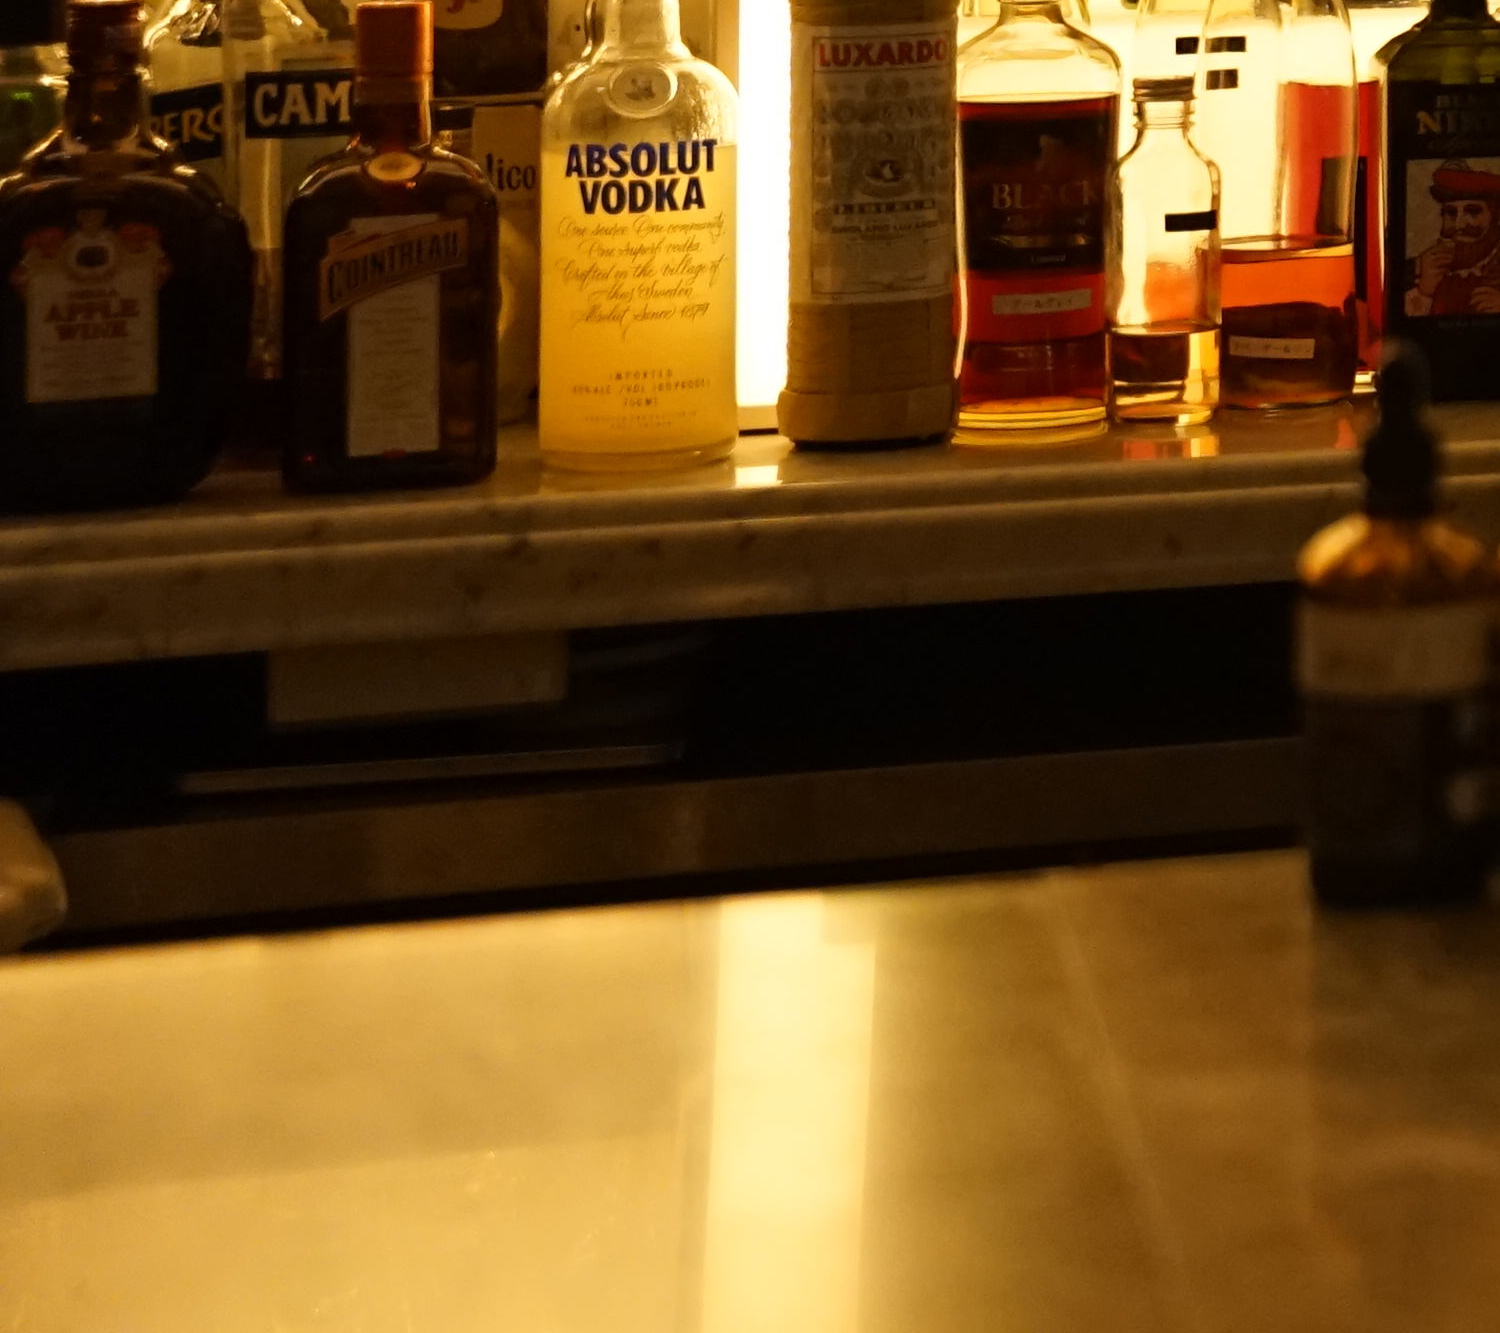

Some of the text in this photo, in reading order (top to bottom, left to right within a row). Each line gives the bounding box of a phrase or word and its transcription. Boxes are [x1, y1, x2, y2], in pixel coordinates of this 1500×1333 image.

[818, 37, 948, 69] LUXARDO
[564, 138, 719, 180] ABSOLUT
[578, 177, 706, 215] VODKA
[326, 229, 462, 303] COINTREAU
